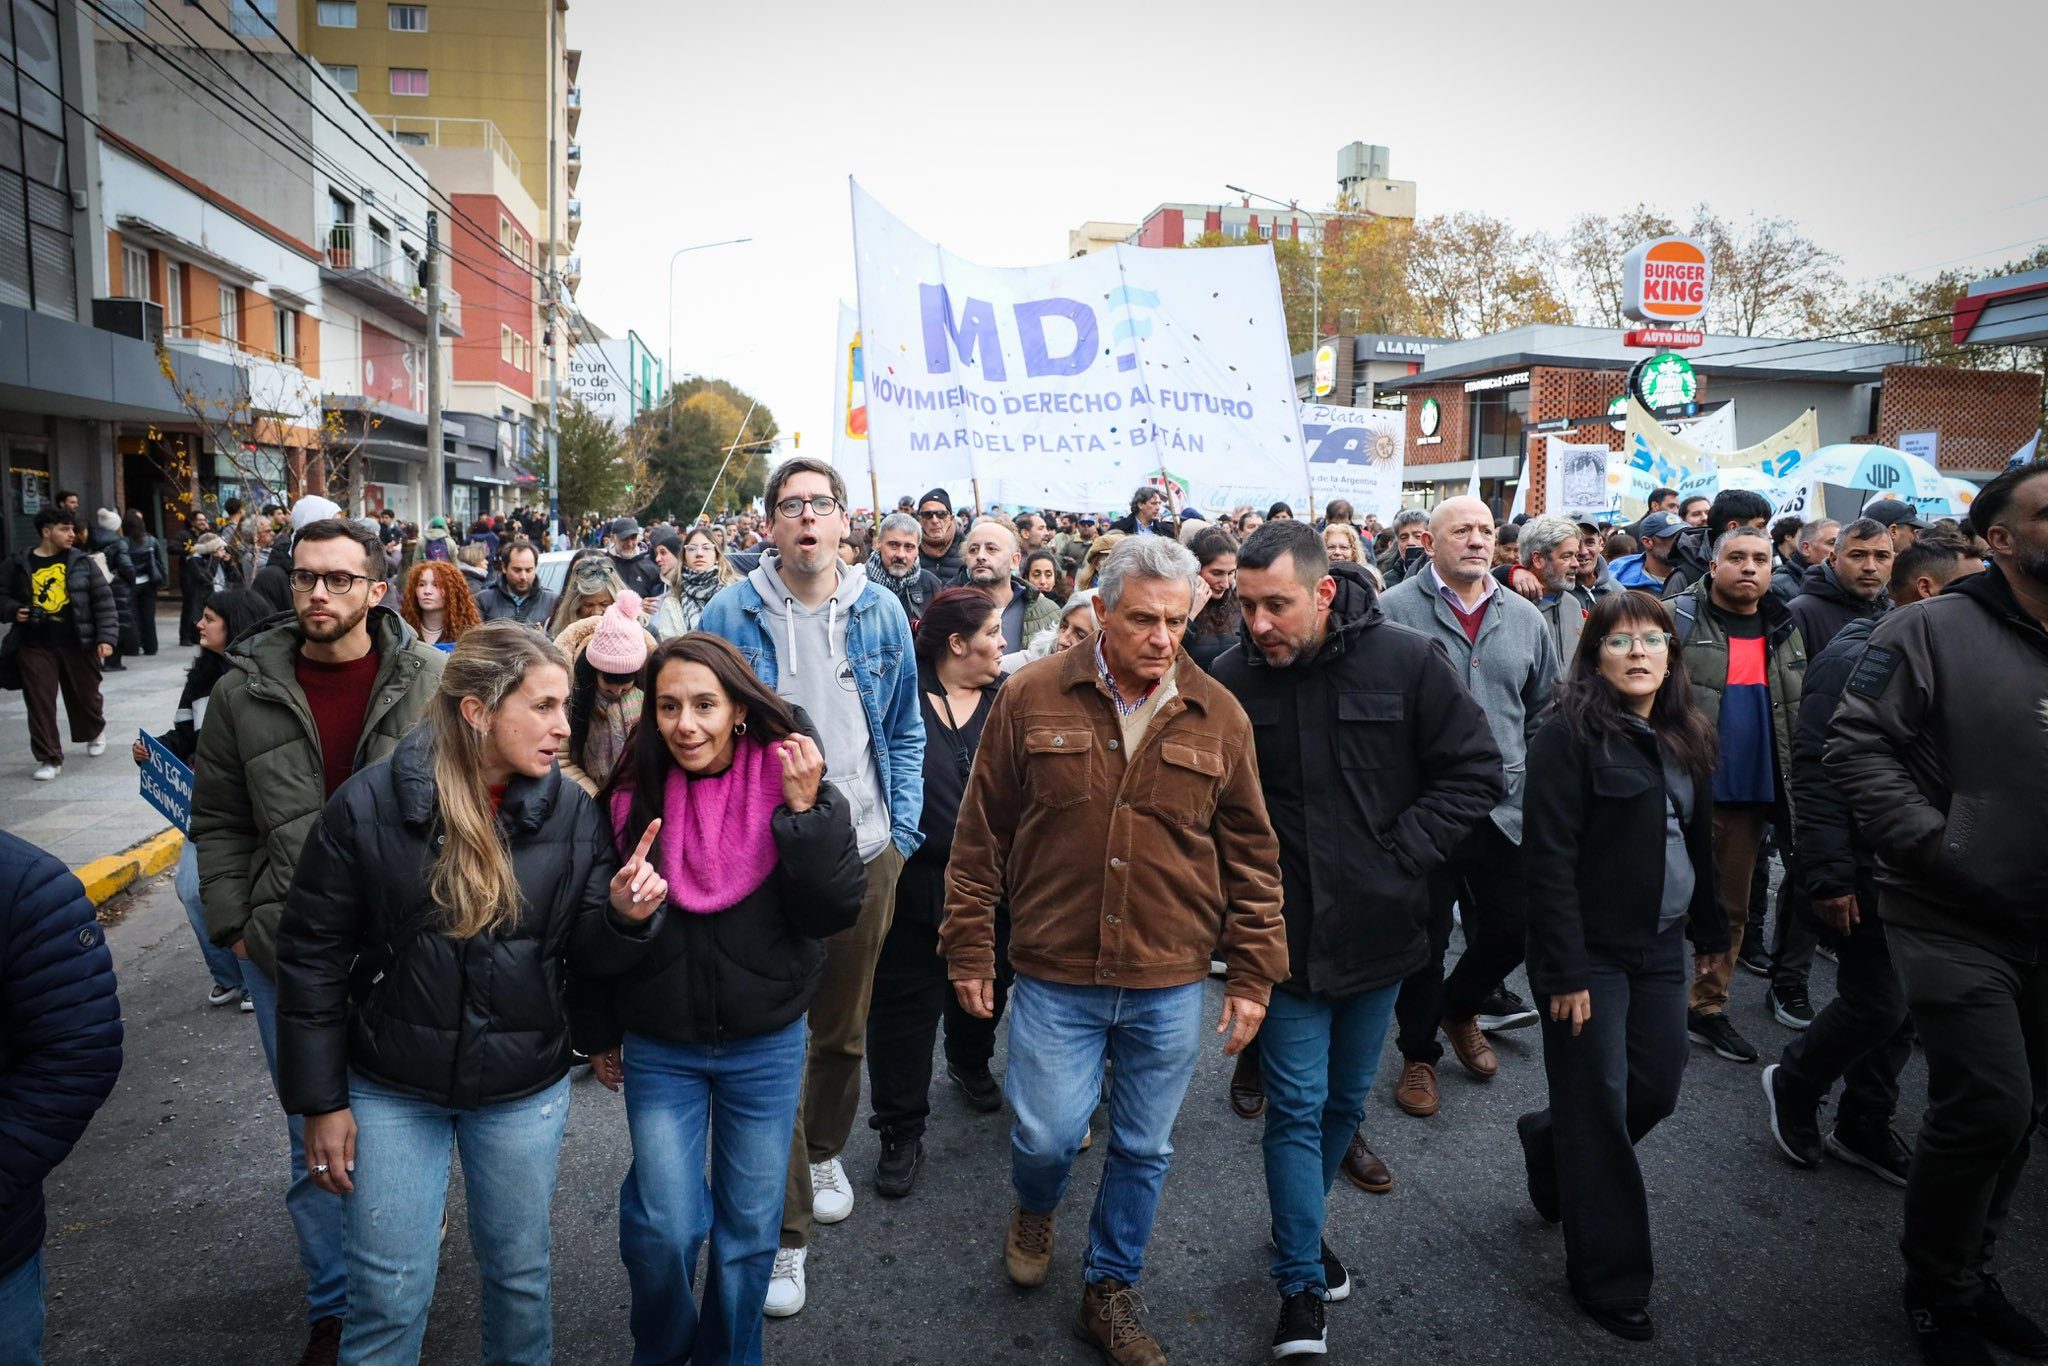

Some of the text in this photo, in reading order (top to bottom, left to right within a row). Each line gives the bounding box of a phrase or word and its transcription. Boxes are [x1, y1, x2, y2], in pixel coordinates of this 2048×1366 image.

[1644, 263, 1705, 281] BURGER
[1643, 279, 1704, 303] KING
[1643, 331, 1701, 345] AUTO KING
[1375, 341, 1387, 353] A
[1387, 341, 1405, 354] LA
[588, 363, 607, 374] un
[591, 375, 609, 388] de
[872, 371, 1254, 420] MOVIMIENTO DERECHO AL FUTURO
[1313, 405, 1365, 424] Plata
[910, 428, 969, 451] MAR
[972, 430, 1015, 452] DEL
[1022, 433, 1106, 453] PLATA
[1129, 423, 1204, 453] BATÁN
[1679, 474, 1718, 491] MDP
[1866, 464, 1901, 489] JUP
